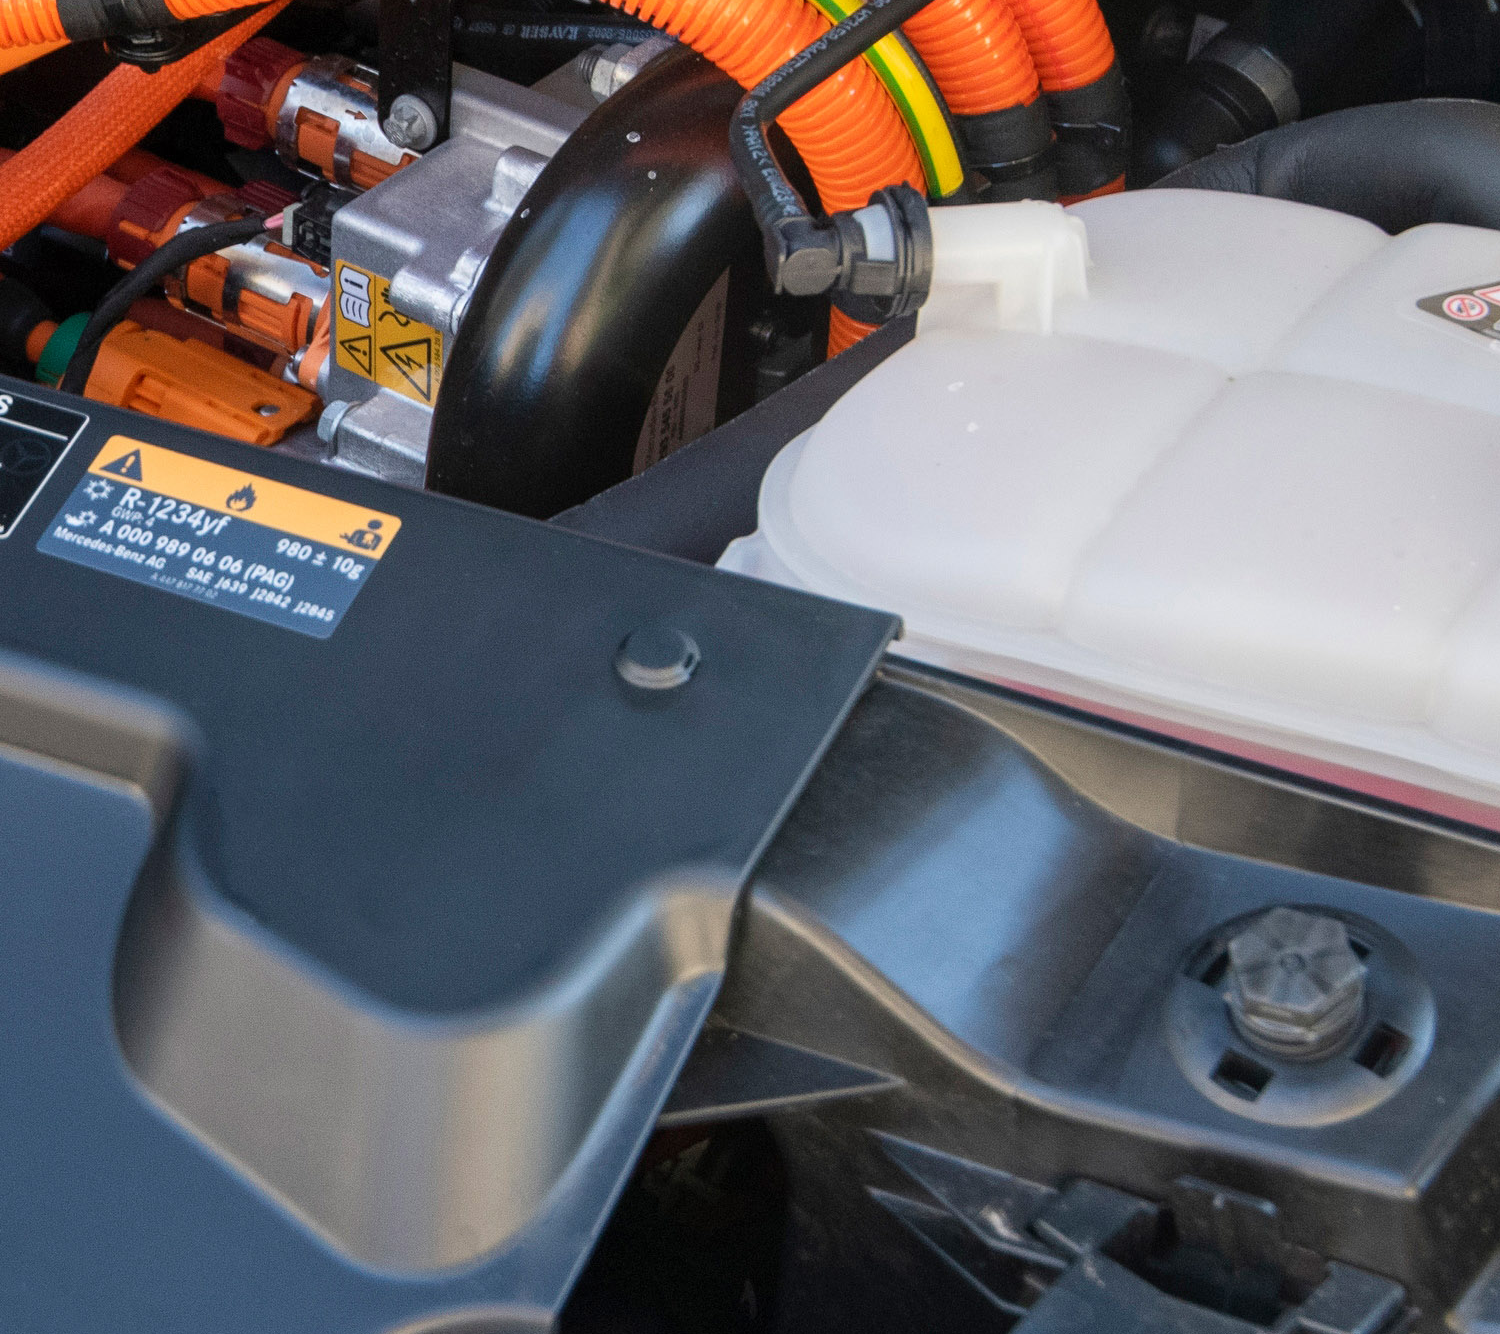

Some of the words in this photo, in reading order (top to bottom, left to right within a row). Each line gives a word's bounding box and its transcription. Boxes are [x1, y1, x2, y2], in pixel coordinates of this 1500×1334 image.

[521, 25, 579, 40] KAYSER
[111, 506, 144, 523] GWP:
[145, 517, 155, 528] 4
[119, 487, 230, 538] R-1234yf
[276, 538, 313, 561] 980
[312, 551, 327, 566] ±
[332, 555, 365, 581] 10g
[53, 525, 146, 564] Mercedes-Benz
[144, 554, 167, 570] AG
[185, 566, 214, 584] SAE
[215, 577, 246, 595] J639
[249, 587, 292, 609] J2842
[292, 601, 335, 622] J2845
[98, 519, 115, 536] A
[116, 525, 149, 548] 000
[154, 535, 191, 557] 989
[191, 546, 217, 566] 06
[218, 555, 243, 575] 06
[243, 563, 295, 593] (PAG)
